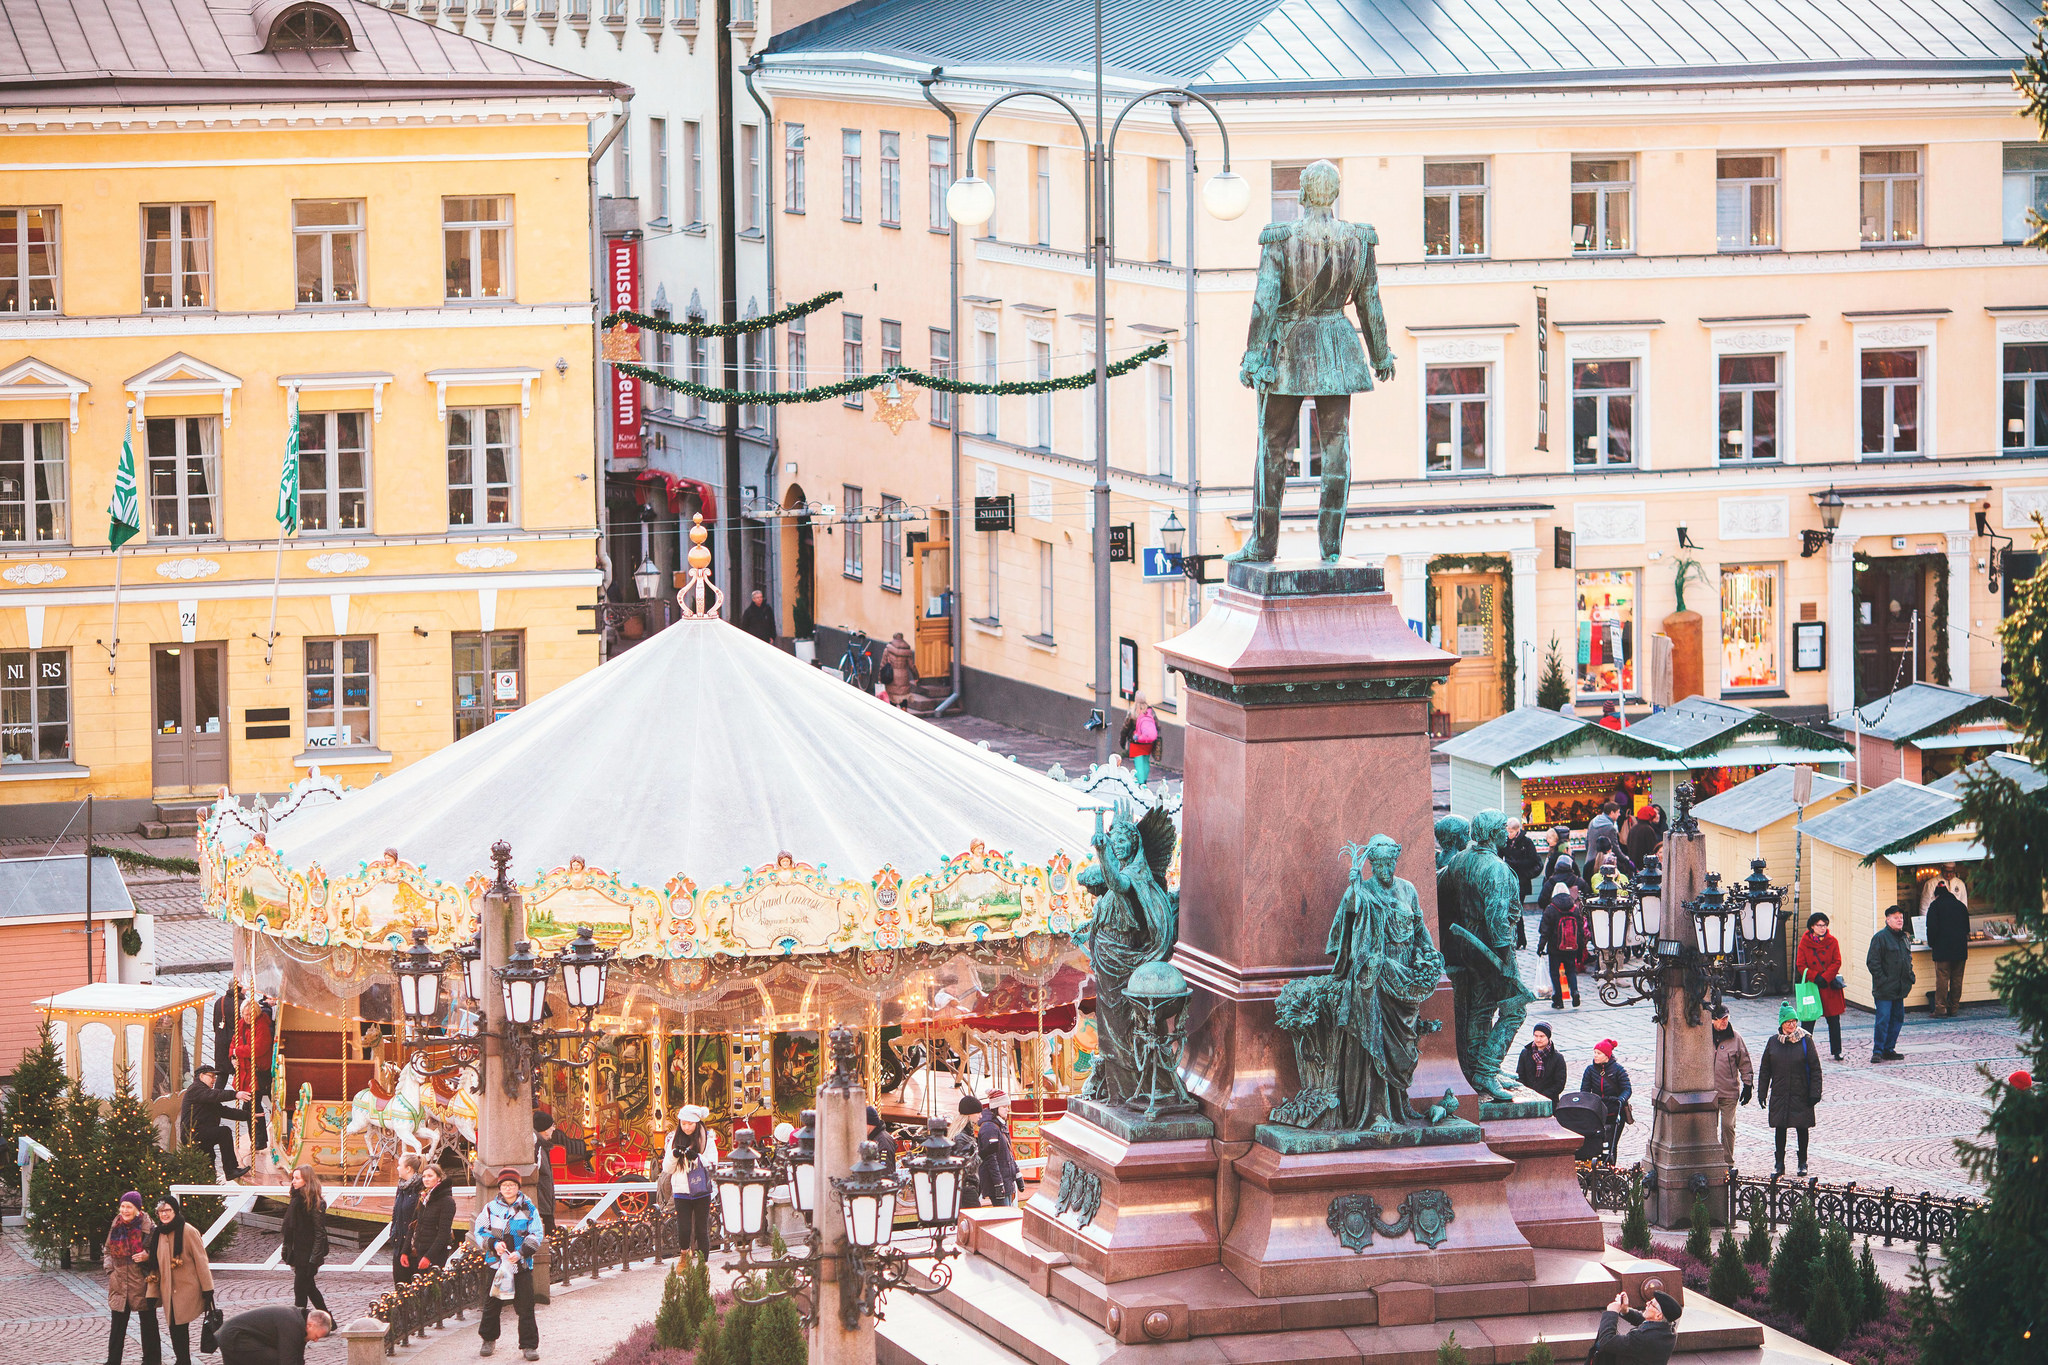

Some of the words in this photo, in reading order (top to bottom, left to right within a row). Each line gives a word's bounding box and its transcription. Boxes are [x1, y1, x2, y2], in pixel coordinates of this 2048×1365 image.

[182, 613, 196, 627] 24
[7, 664, 24, 679] NI
[42, 662, 61, 678] RS
[309, 737, 337, 747] NCC
[753, 894, 782, 923] Grand
